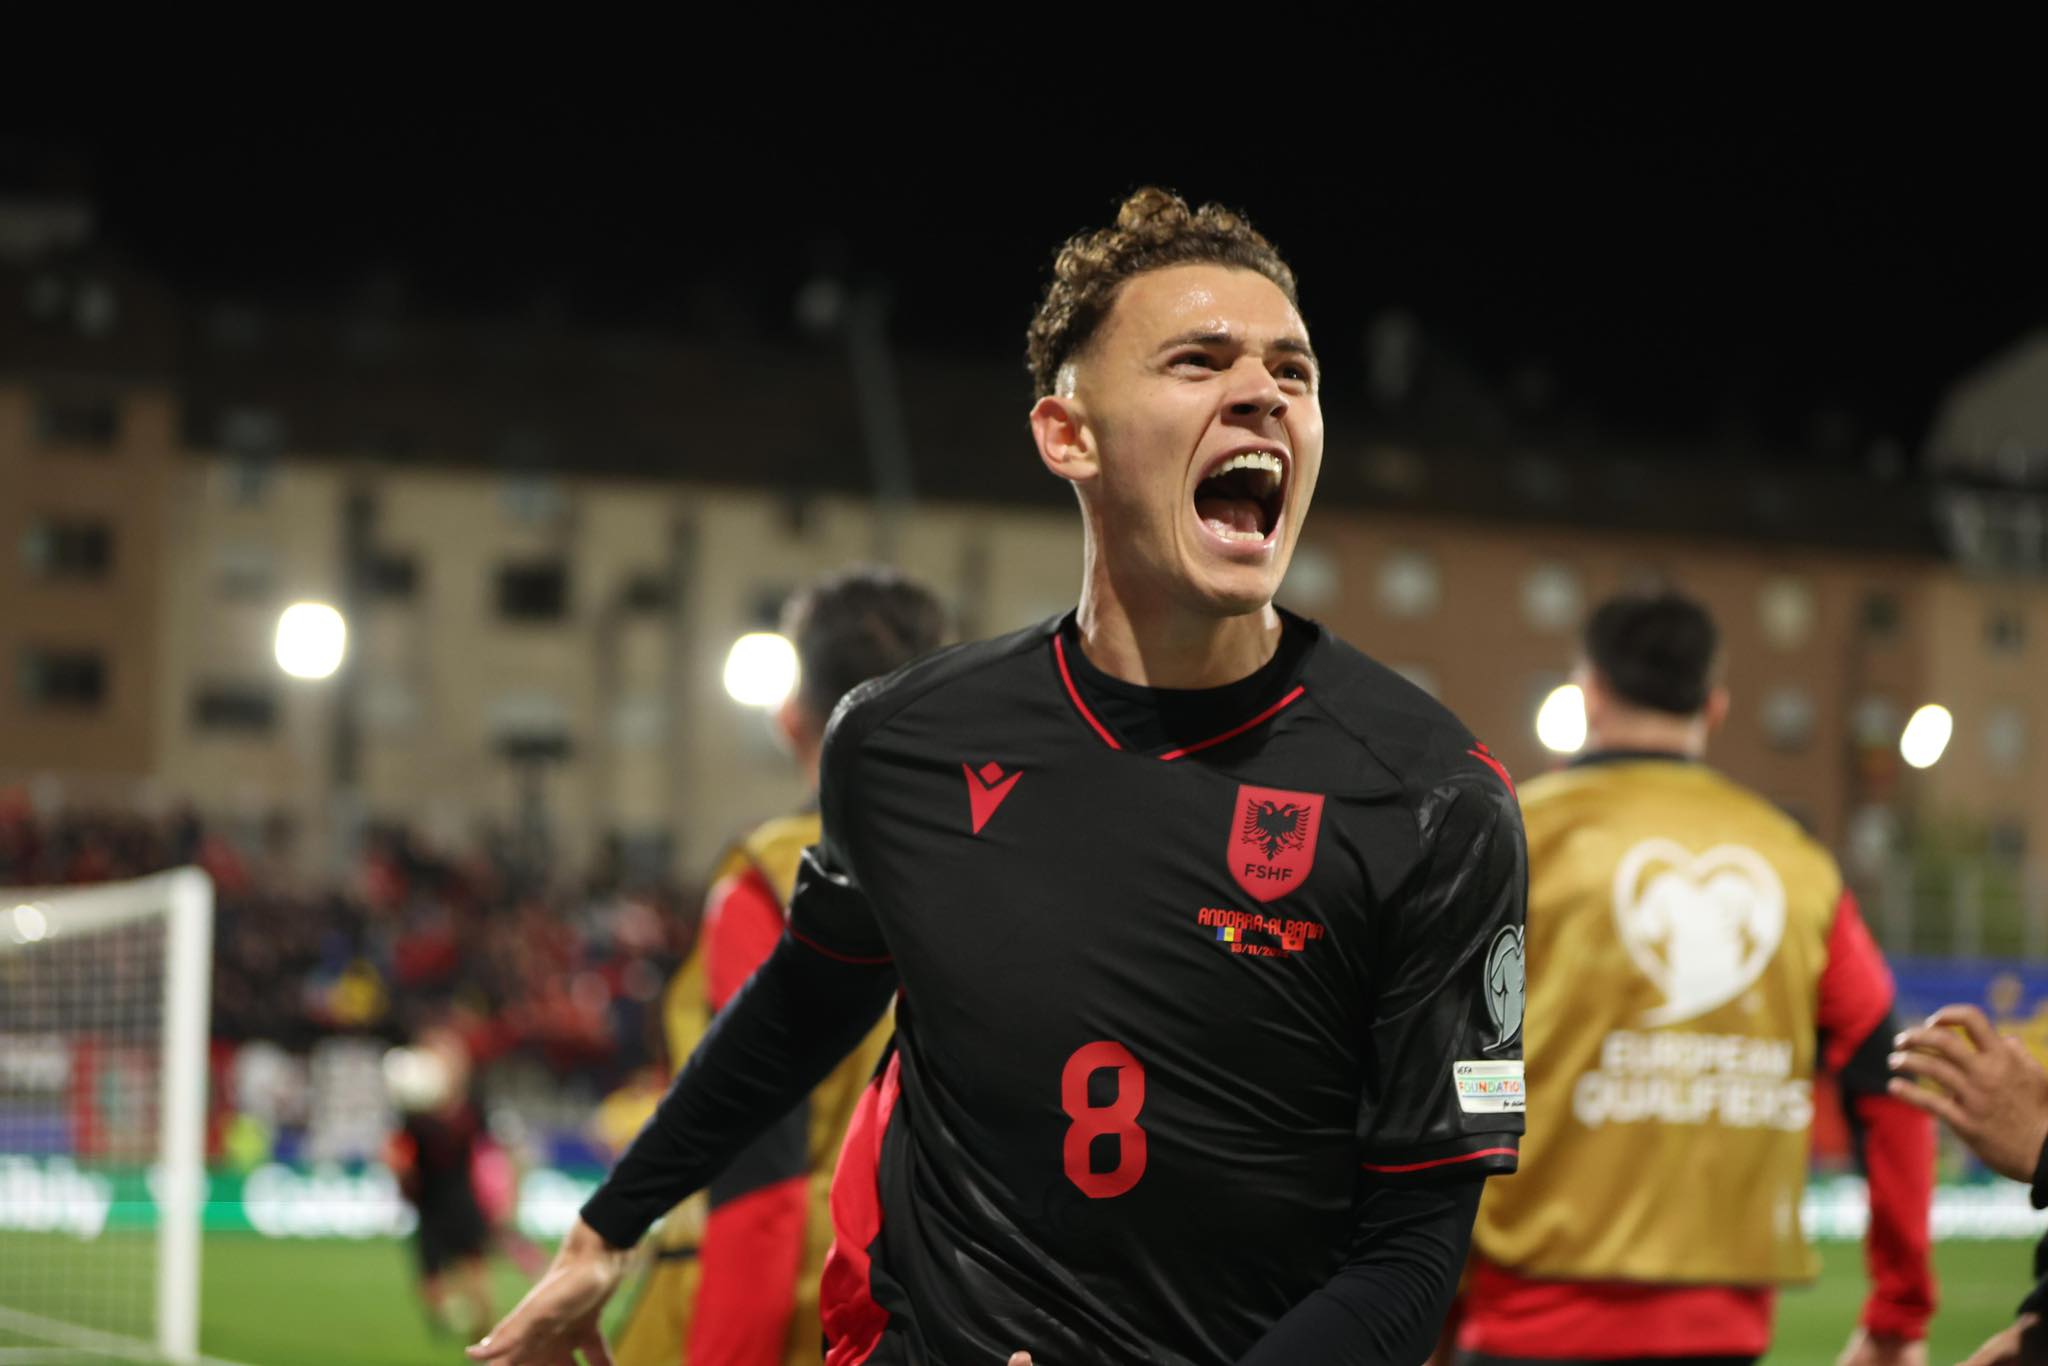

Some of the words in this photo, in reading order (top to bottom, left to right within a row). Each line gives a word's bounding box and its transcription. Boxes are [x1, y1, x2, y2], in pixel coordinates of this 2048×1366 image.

[1244, 863, 1293, 881] FSHF
[1061, 1040, 1147, 1199] 8
[1573, 1071, 1814, 1129] QUALIFIERS
